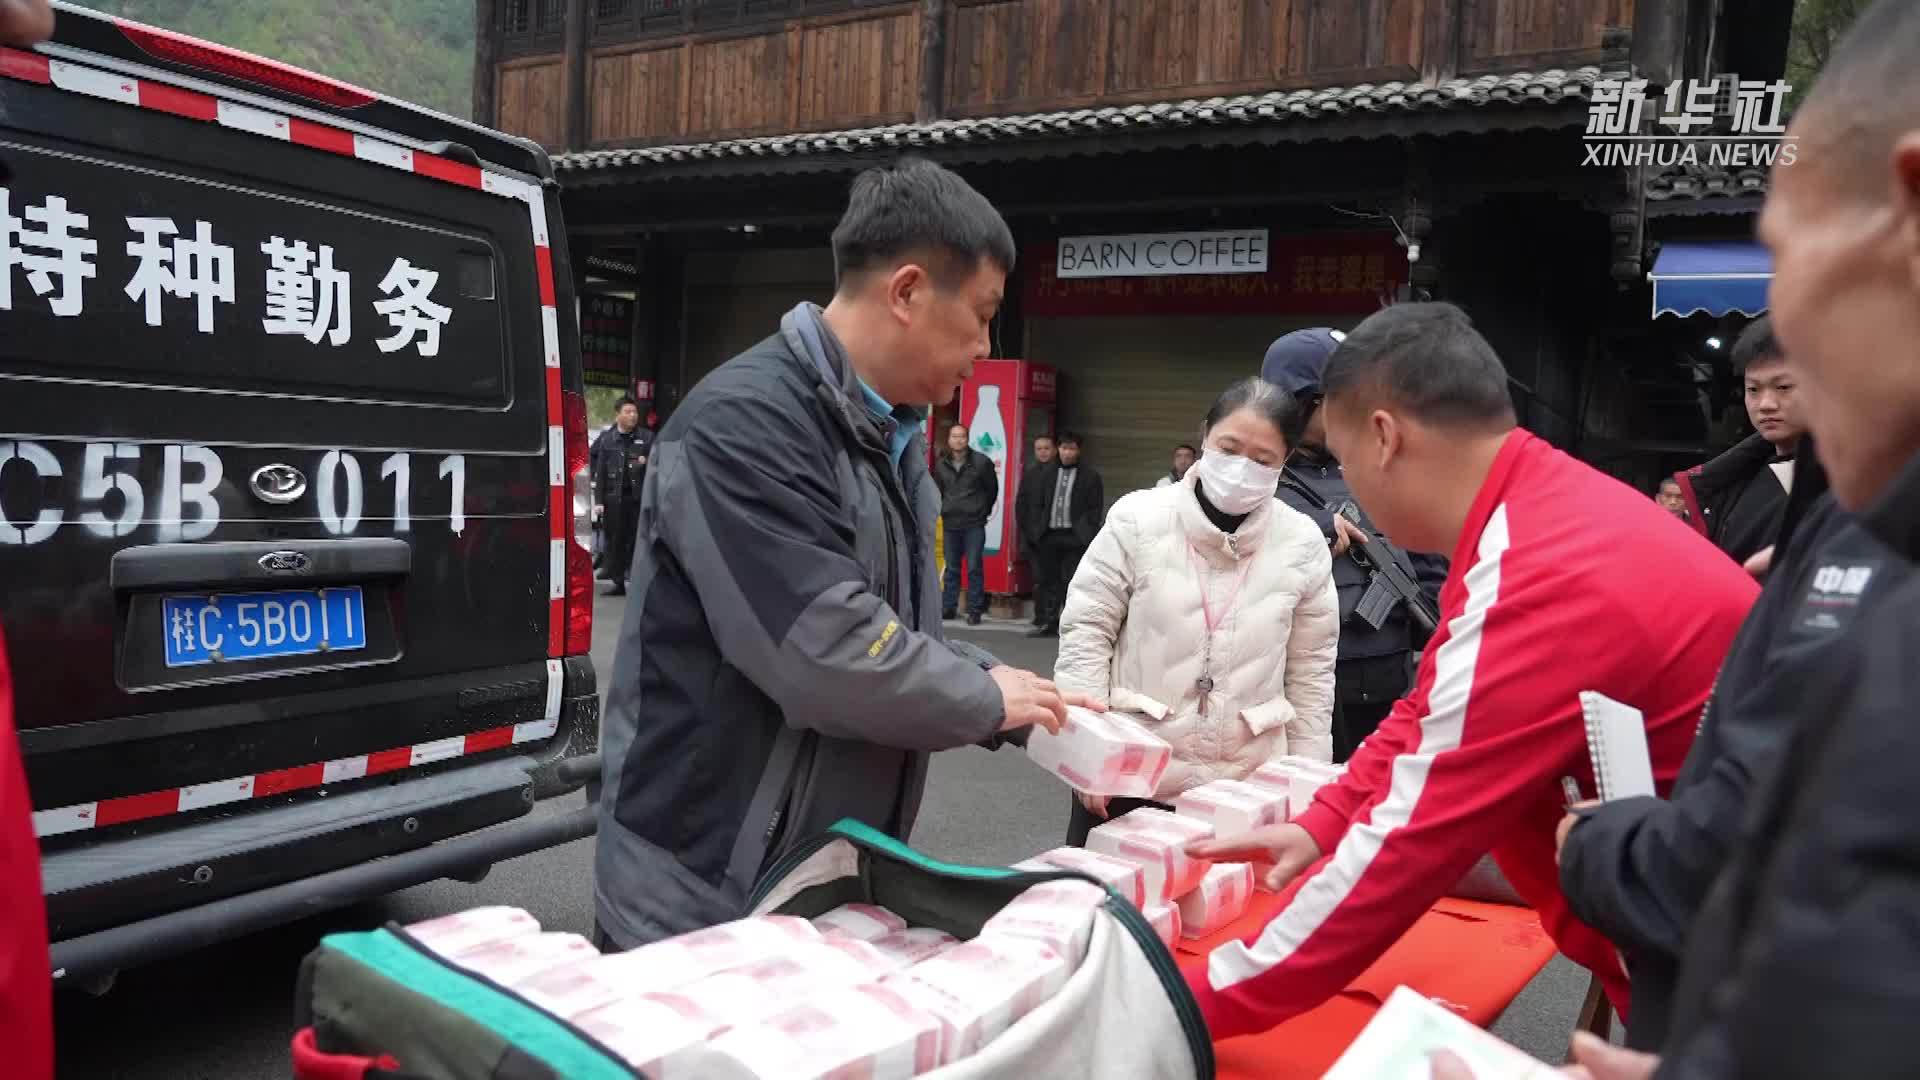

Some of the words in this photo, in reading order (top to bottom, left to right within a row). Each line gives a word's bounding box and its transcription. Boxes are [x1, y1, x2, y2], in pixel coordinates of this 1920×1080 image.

[0, 186, 453, 357] 特种勤务
[1061, 242, 1137, 270] BARN
[1145, 236, 1263, 268] COFFEE
[315, 450, 467, 537] 011
